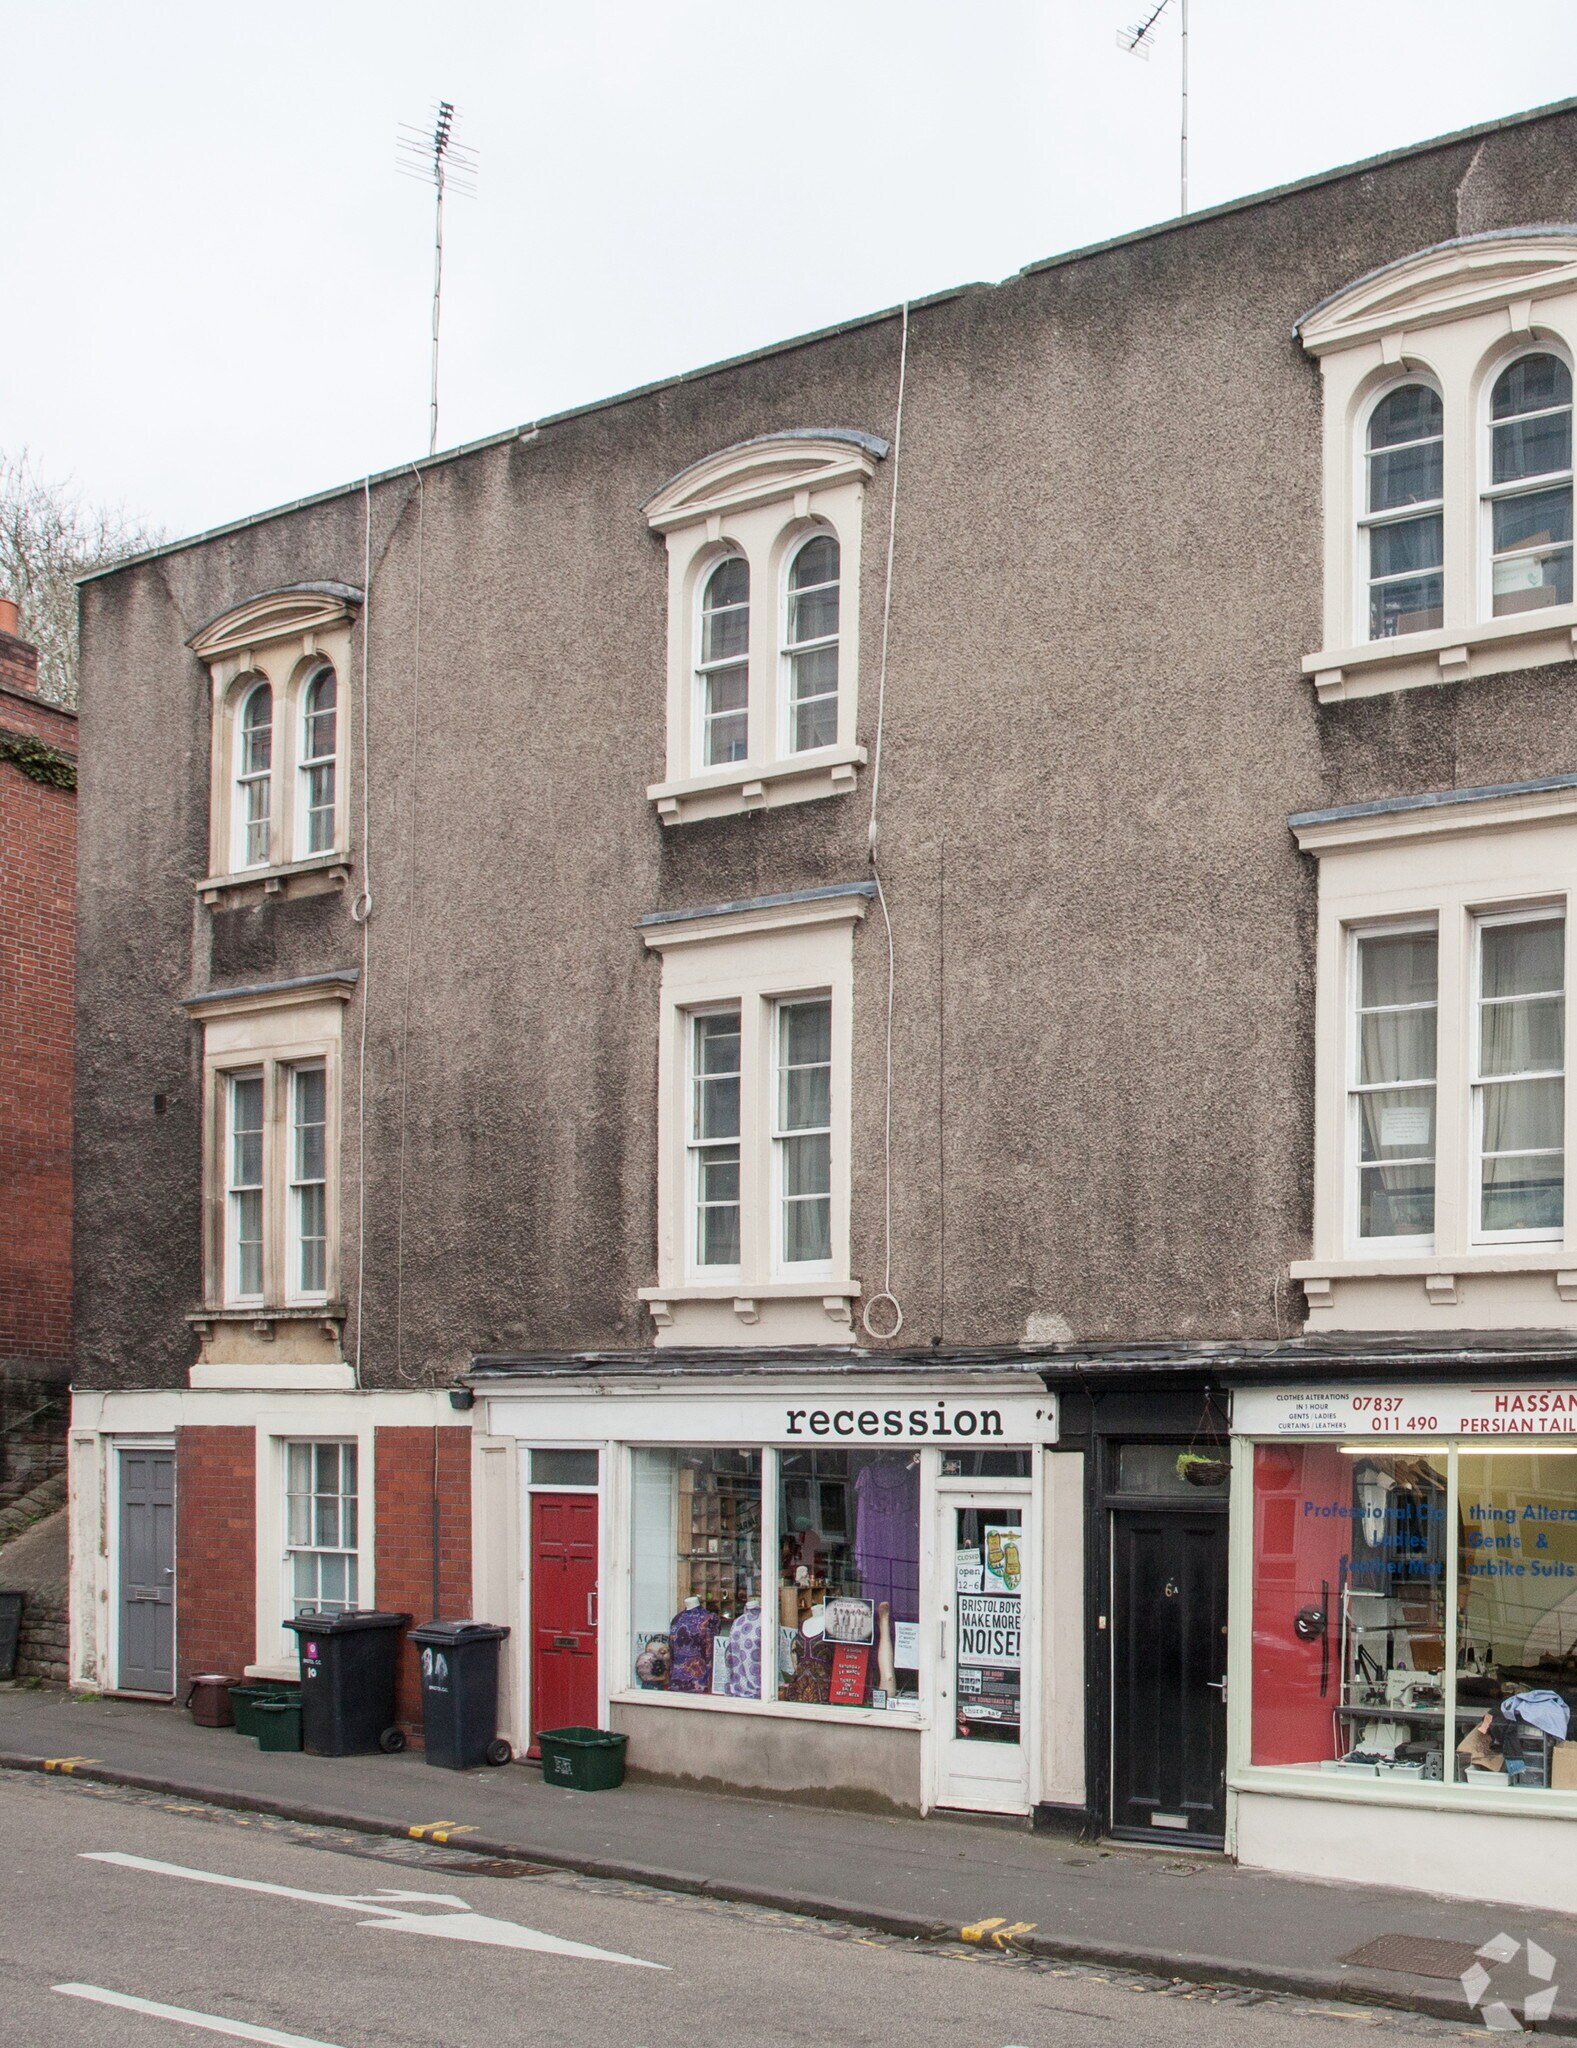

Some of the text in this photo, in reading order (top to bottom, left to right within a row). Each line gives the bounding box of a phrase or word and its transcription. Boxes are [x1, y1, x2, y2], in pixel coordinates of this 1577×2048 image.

[1305, 1393, 1349, 1401] ALTERATIONS
[1352, 1397, 1403, 1412] 07837
[786, 1401, 1004, 1436] recession
[1278, 1422, 1310, 1430] CURTAINS
[1372, 1416, 1437, 1431] 011 490
[1460, 1418, 1534, 1432] PERSIAN
[1304, 1502, 1411, 1519] Professional
[1373, 1530, 1548, 1549] Ladies Gents &
[959, 1569, 981, 1577] open
[1530, 1560, 1575, 1577] Suits
[958, 1581, 980, 1590] 12-6
[962, 1599, 1021, 1614] BRISTOL BOYS
[962, 1613, 1021, 1629] MAKE MORE
[962, 1629, 1020, 1656] NOISE!
